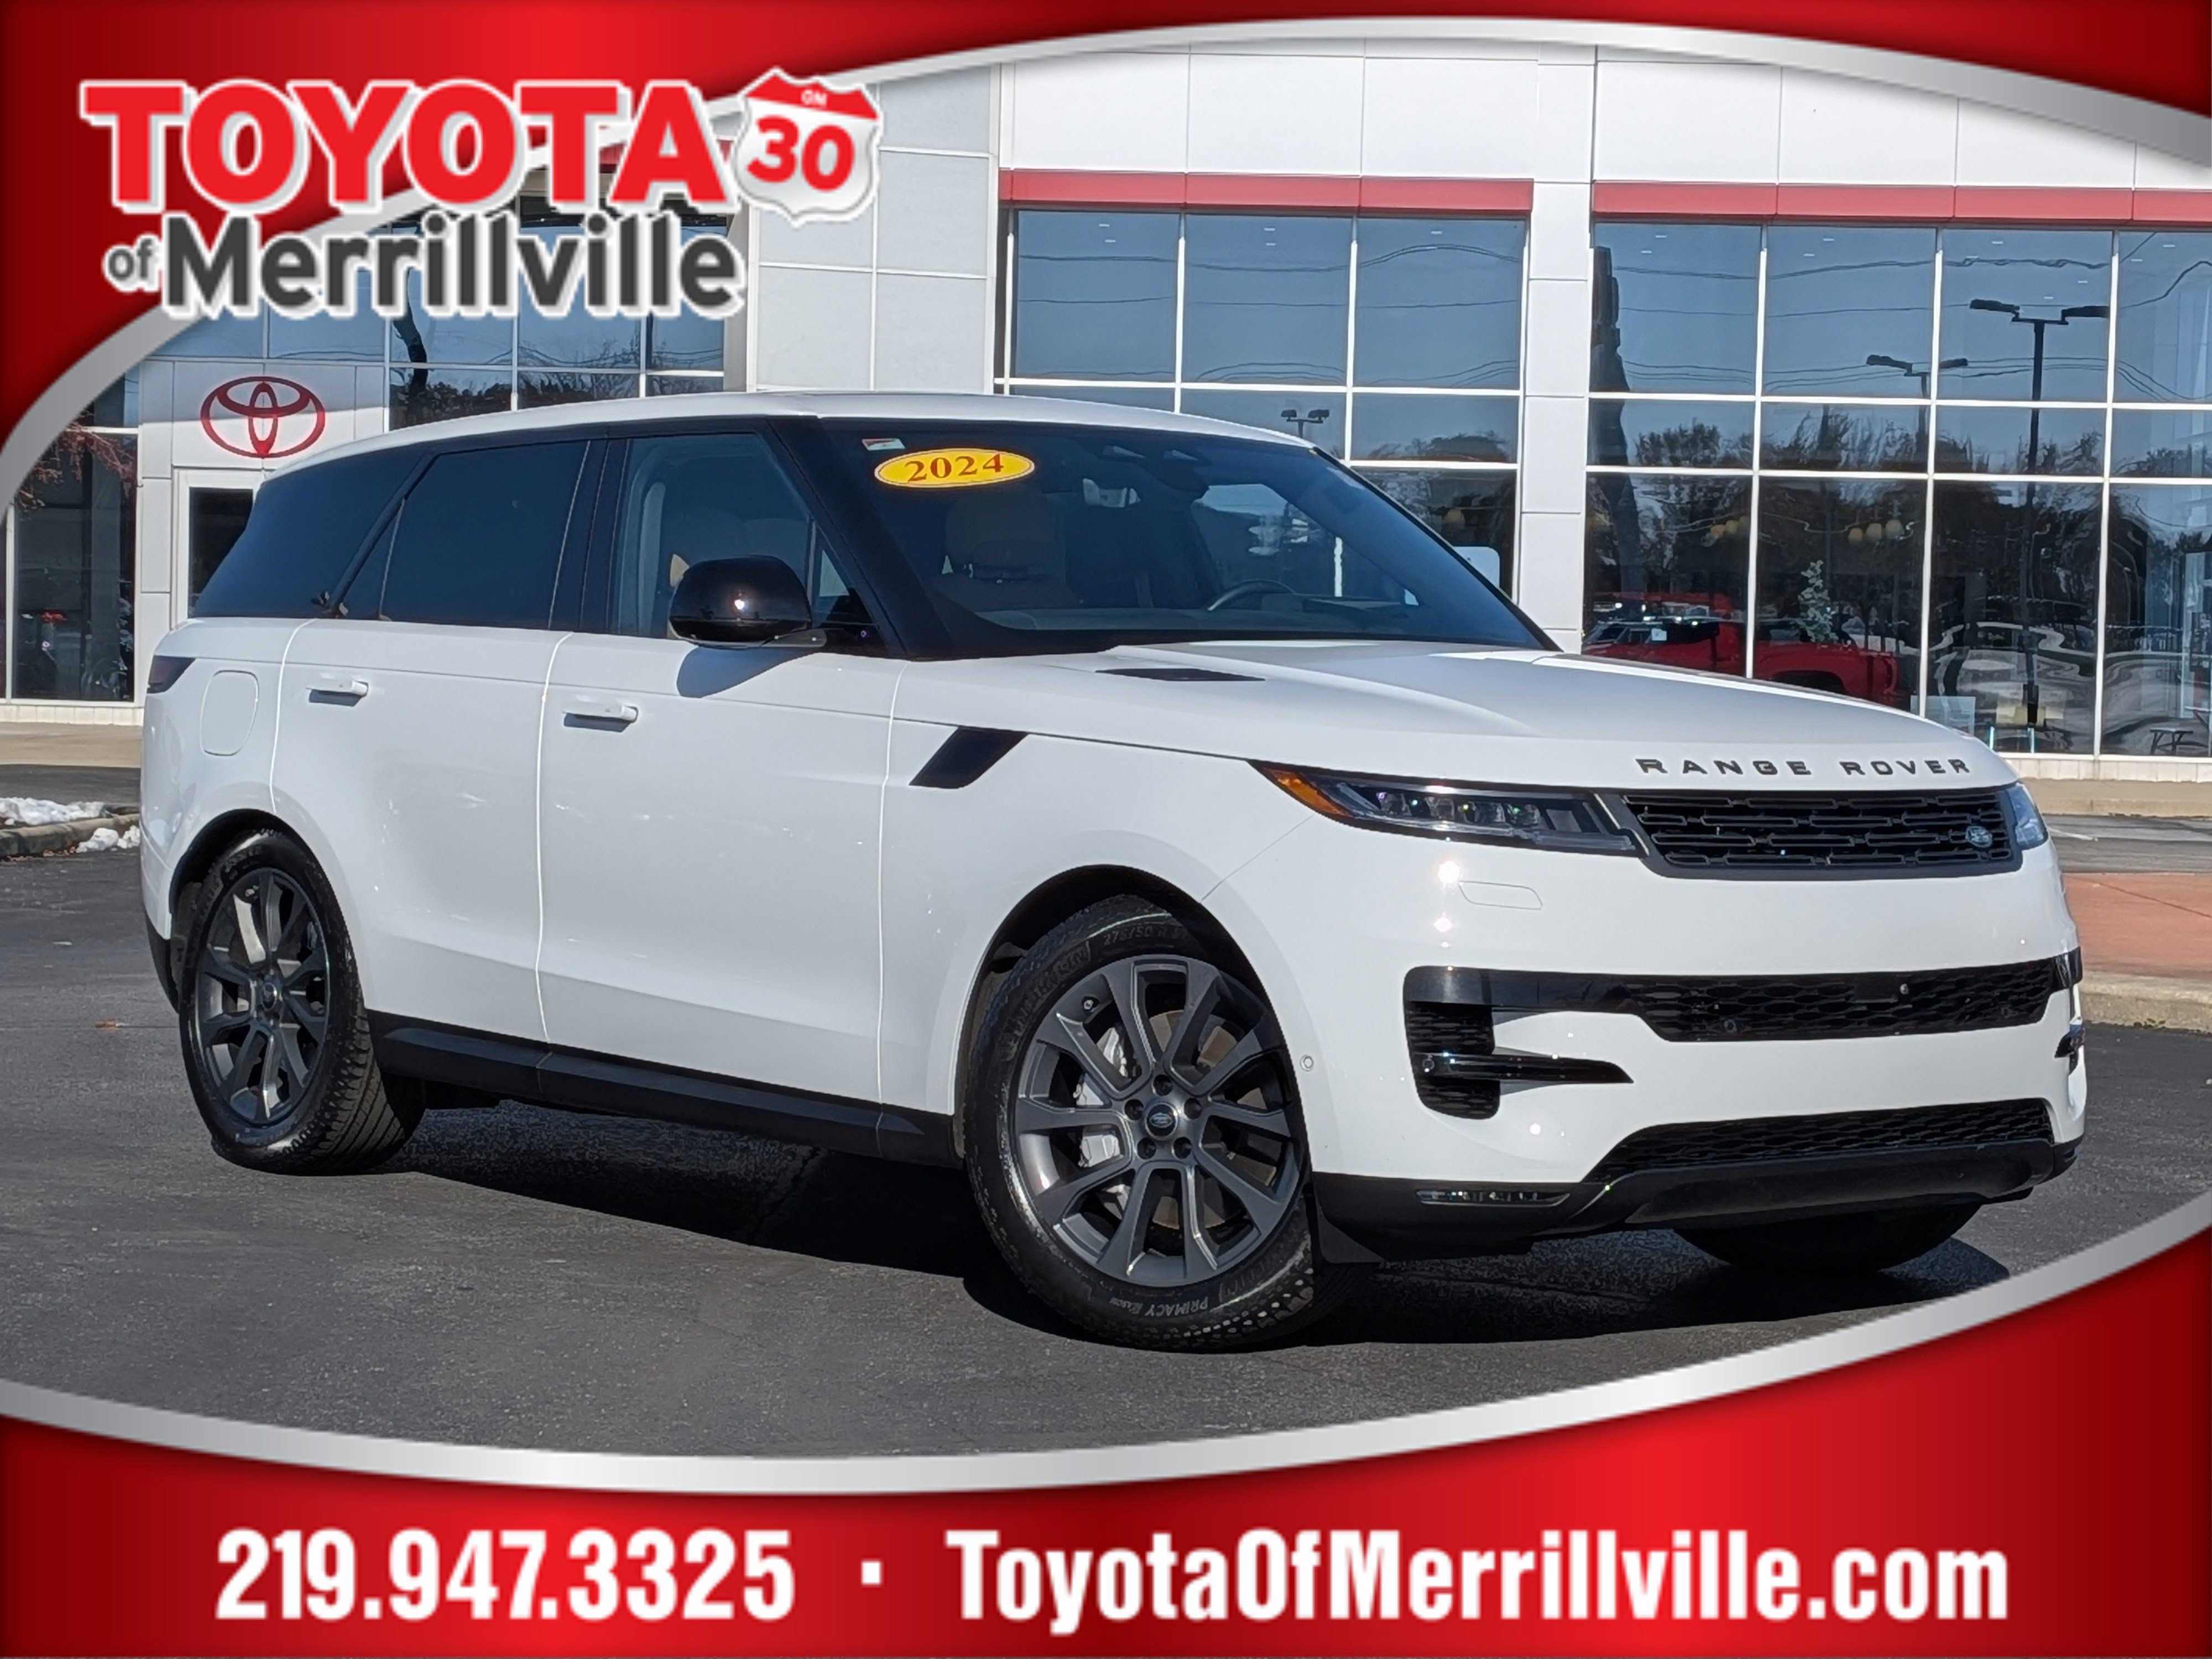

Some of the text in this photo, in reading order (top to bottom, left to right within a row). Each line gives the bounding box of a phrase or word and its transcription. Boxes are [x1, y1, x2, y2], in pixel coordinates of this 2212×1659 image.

[904, 453, 1005, 483] 2024
[1635, 758, 1970, 775] RANGE ROVER
[1144, 1296, 1209, 1317] PRIMACY
